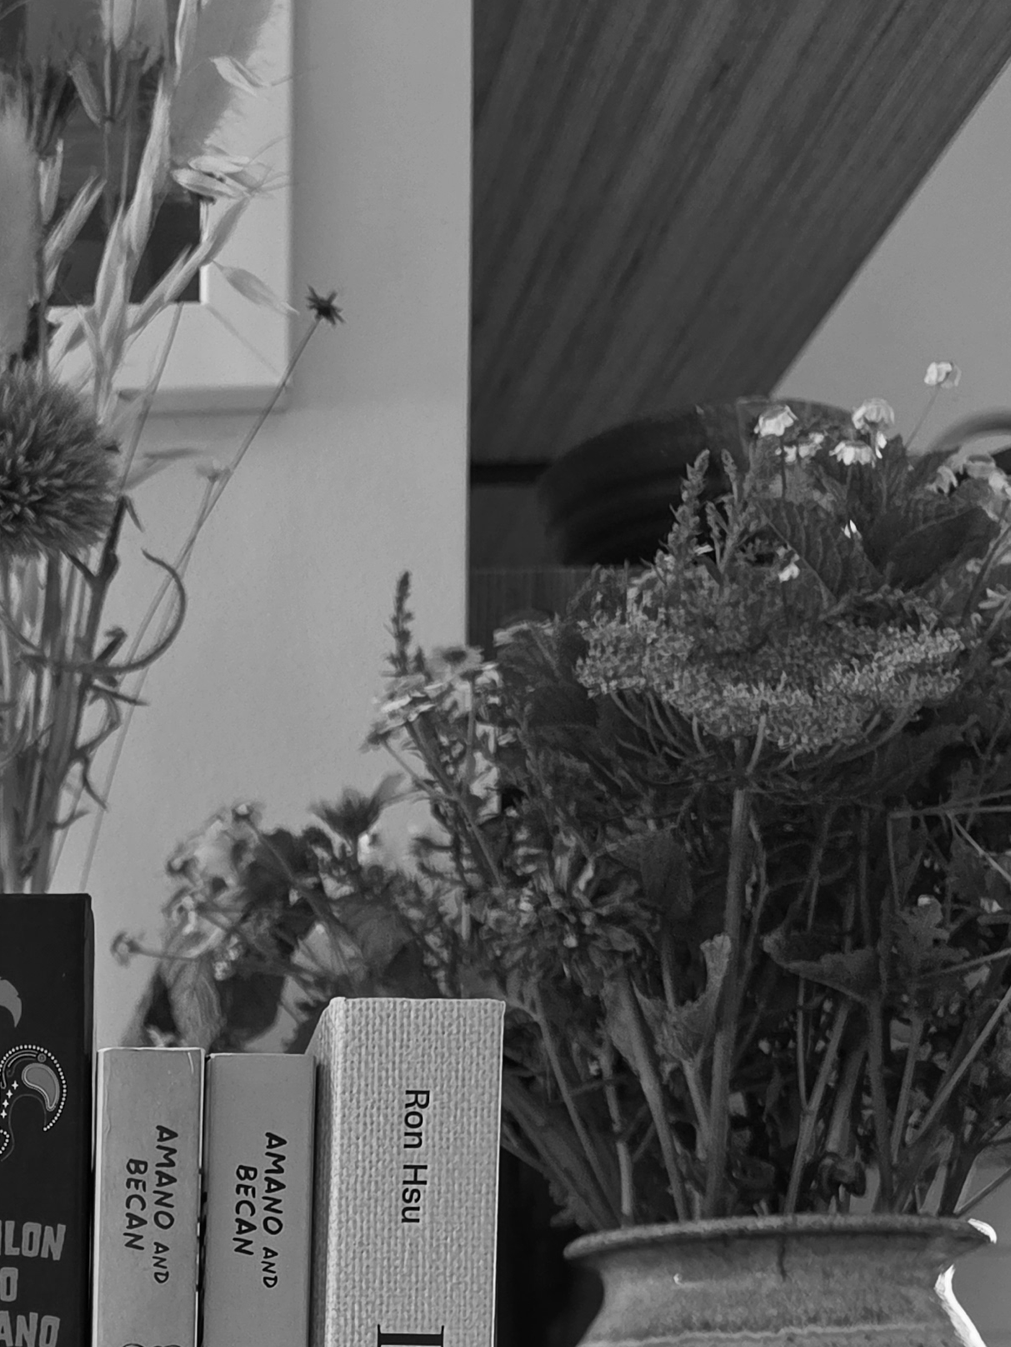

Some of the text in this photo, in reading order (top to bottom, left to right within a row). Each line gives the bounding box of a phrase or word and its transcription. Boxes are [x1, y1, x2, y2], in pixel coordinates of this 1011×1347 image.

[123, 1159, 148, 1250] BECAN
[152, 1125, 178, 1284] AMANO AND
[233, 1165, 257, 1255] BECAN
[261, 1132, 287, 1288] AMANO AND
[400, 1089, 430, 1225] Ron Hsu
